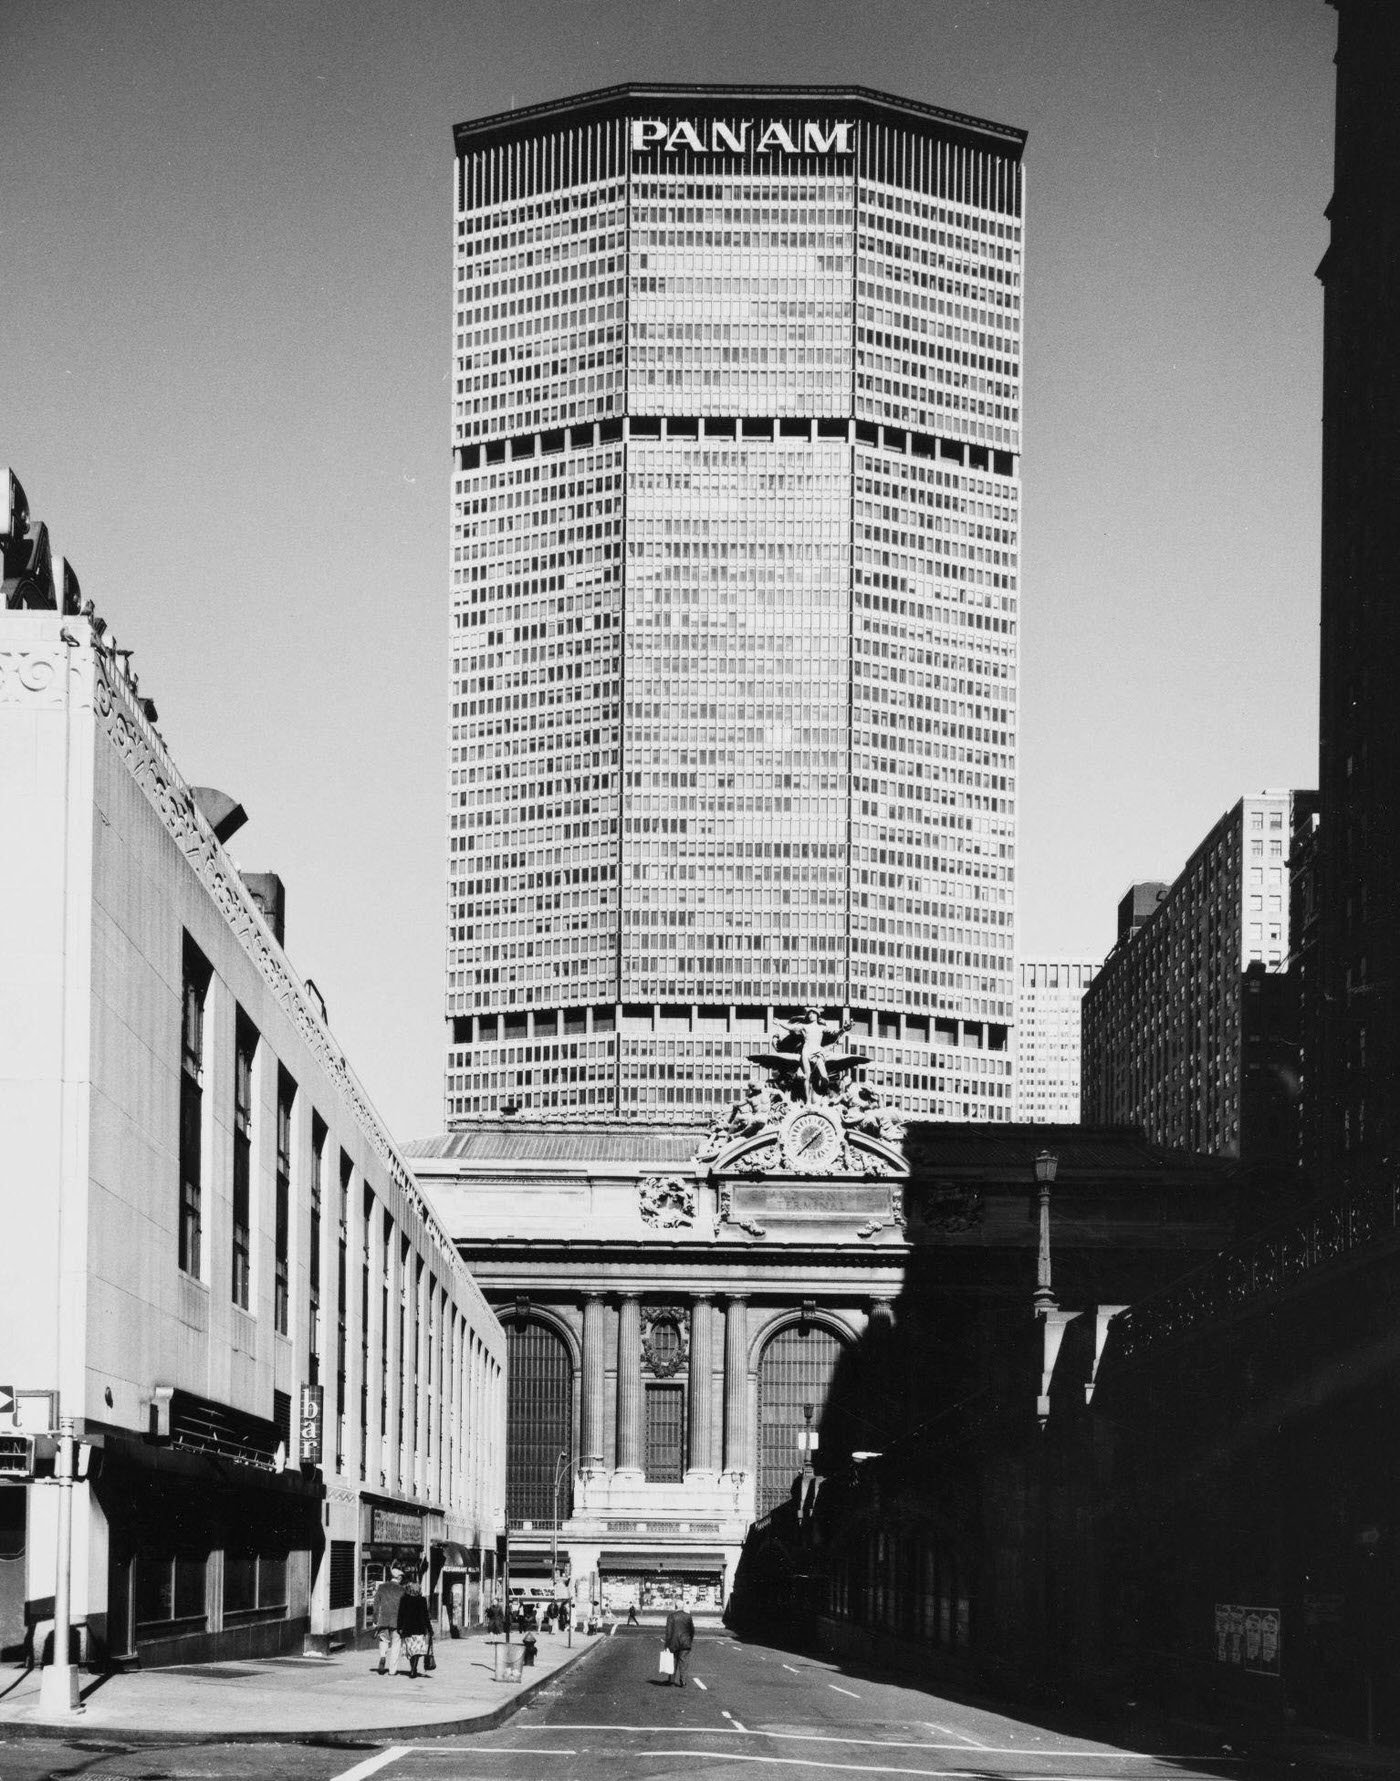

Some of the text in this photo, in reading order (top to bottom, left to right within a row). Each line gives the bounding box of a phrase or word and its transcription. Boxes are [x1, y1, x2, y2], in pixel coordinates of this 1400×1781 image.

[632, 120, 856, 153] PAN AM
[301, 1388, 319, 1459] bar
